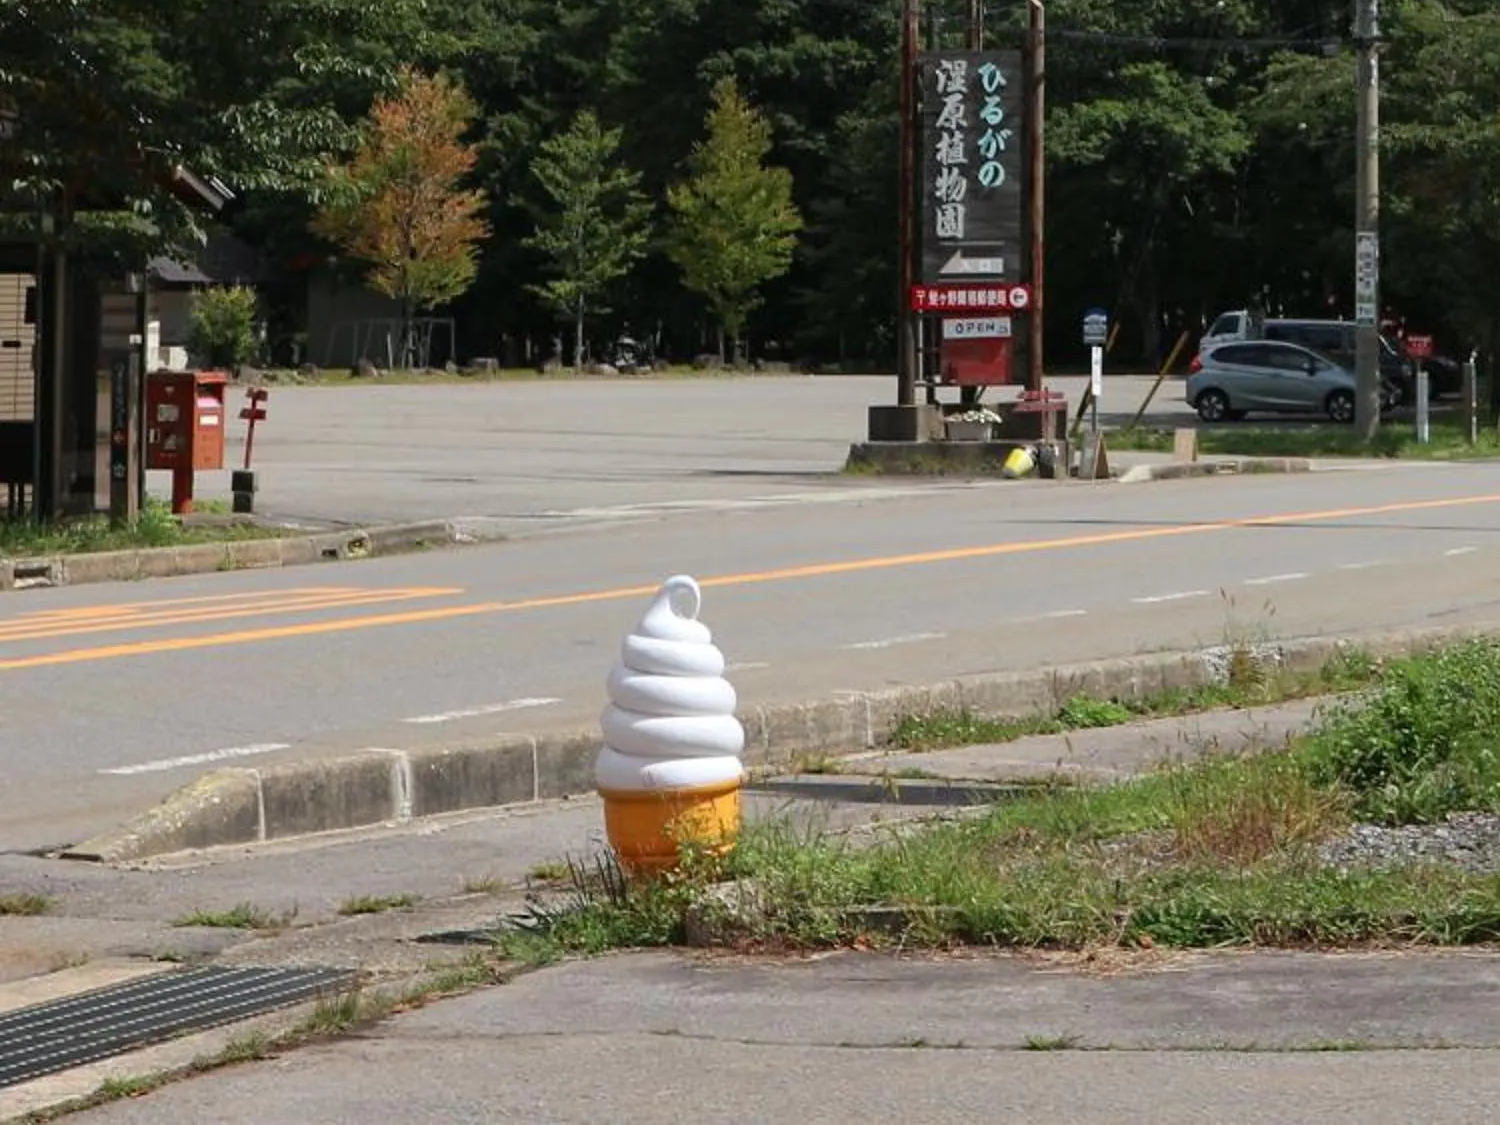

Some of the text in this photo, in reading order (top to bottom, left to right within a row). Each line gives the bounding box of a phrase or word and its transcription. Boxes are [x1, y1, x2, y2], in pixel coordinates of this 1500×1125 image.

[935, 59, 968, 239] 湿原植物園
[977, 61, 1012, 187] ひるがの
[955, 322, 995, 334] OPEN
